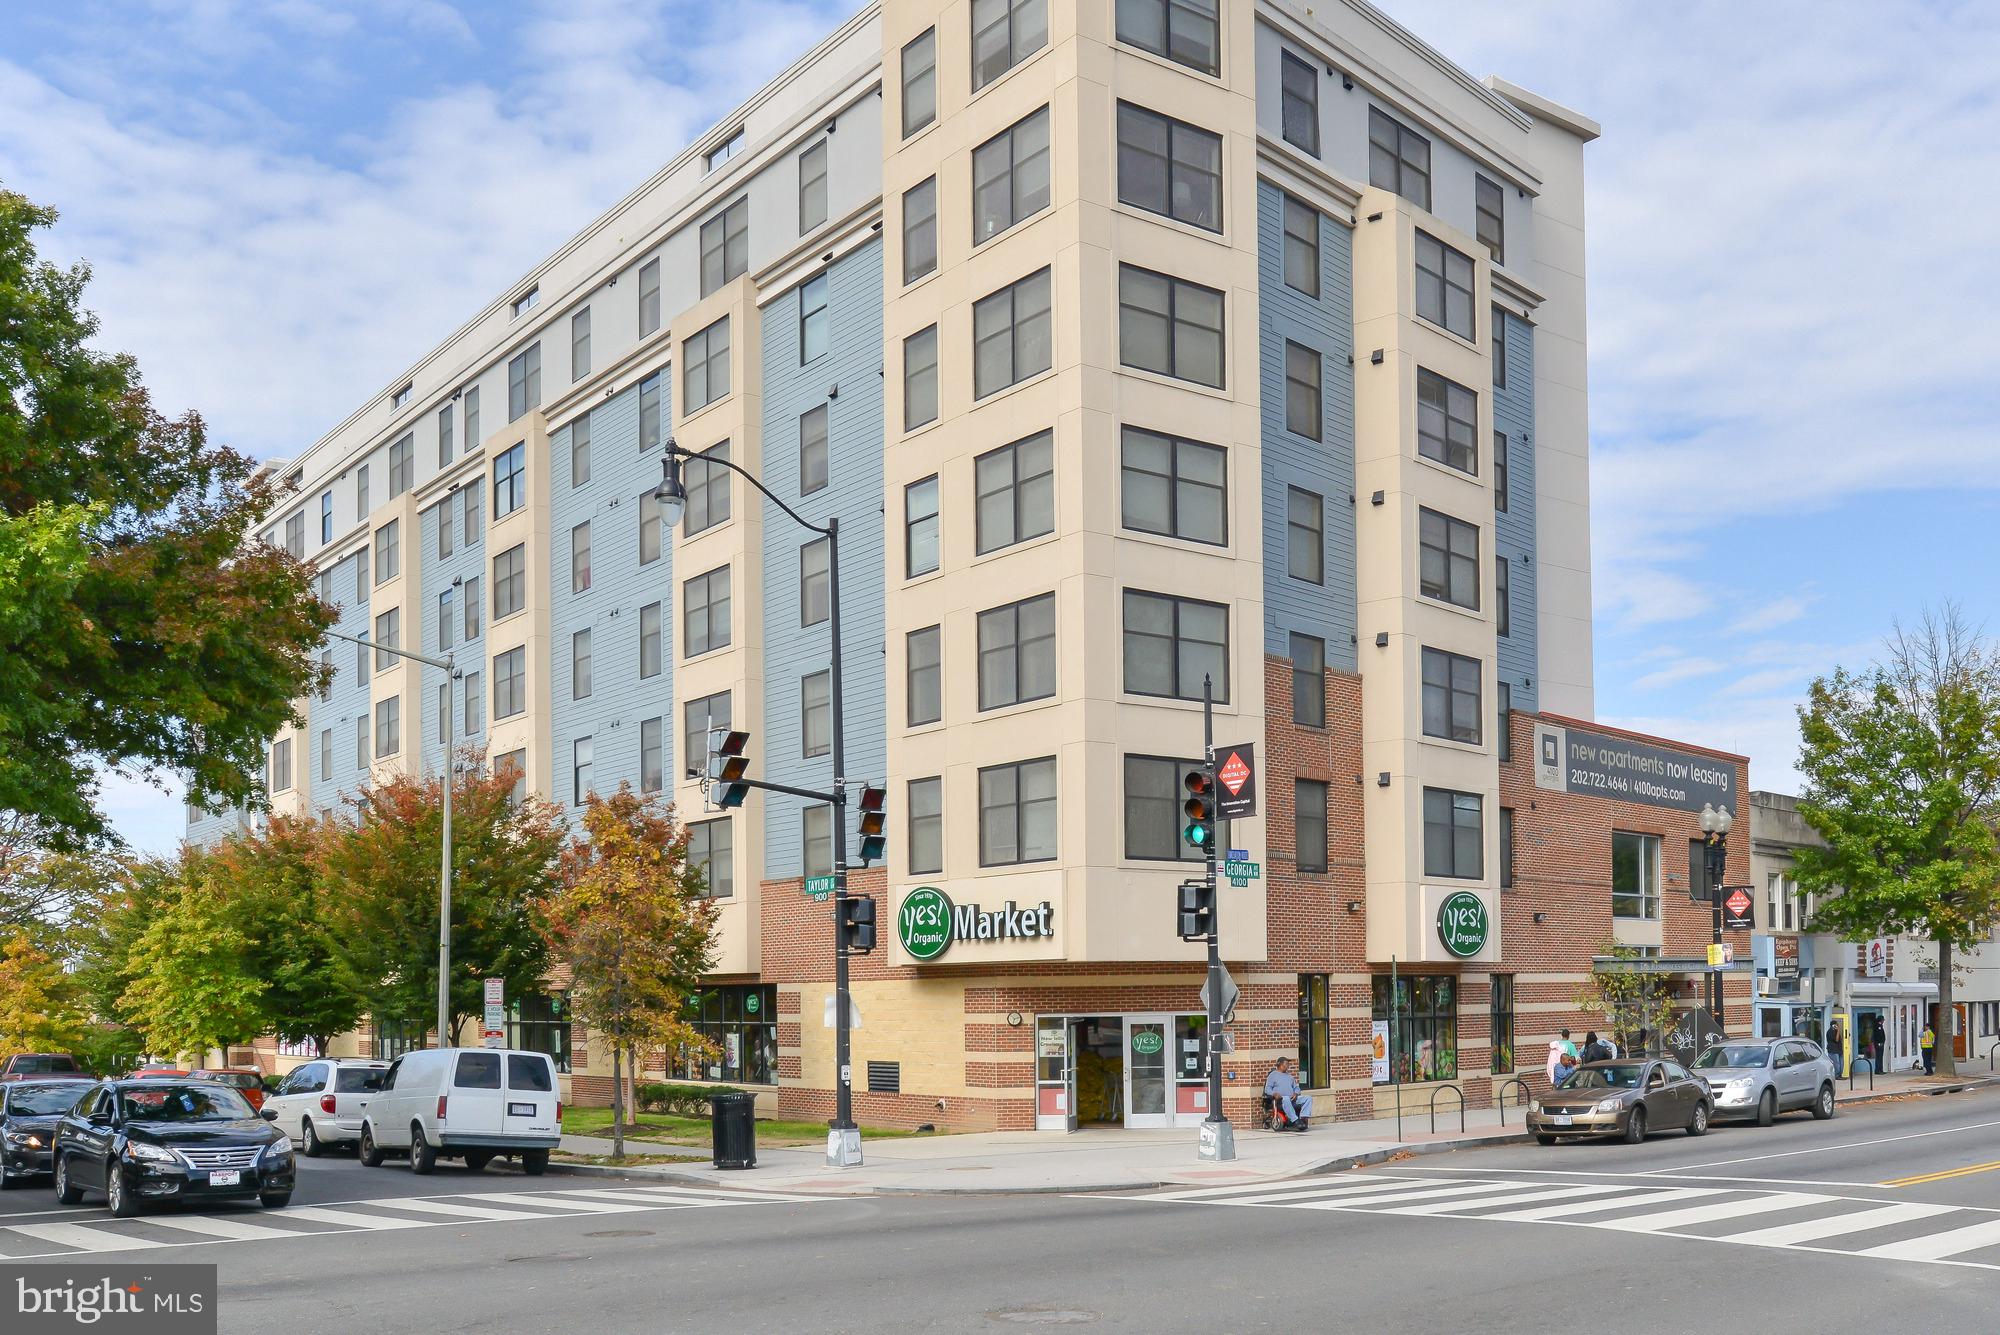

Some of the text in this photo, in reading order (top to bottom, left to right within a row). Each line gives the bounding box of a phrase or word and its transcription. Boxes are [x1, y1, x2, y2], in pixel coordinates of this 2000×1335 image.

[1571, 743, 1728, 792] new apartments now leasing
[1222, 771, 1239, 779] DIGITAL
[1571, 769, 1686, 801] 202.722.4646 4100apts.com
[1226, 863, 1253, 877] GEORGIA
[808, 879, 829, 892] TAYLOR
[1232, 878, 1247, 887] 4100
[814, 892, 827, 902] 900
[903, 900, 943, 947] yes!
[1447, 904, 1482, 945] yes!
[913, 931, 943, 946] Organic
[1457, 933, 1482, 945] Organic
[1136, 1036, 1159, 1050] yes!
